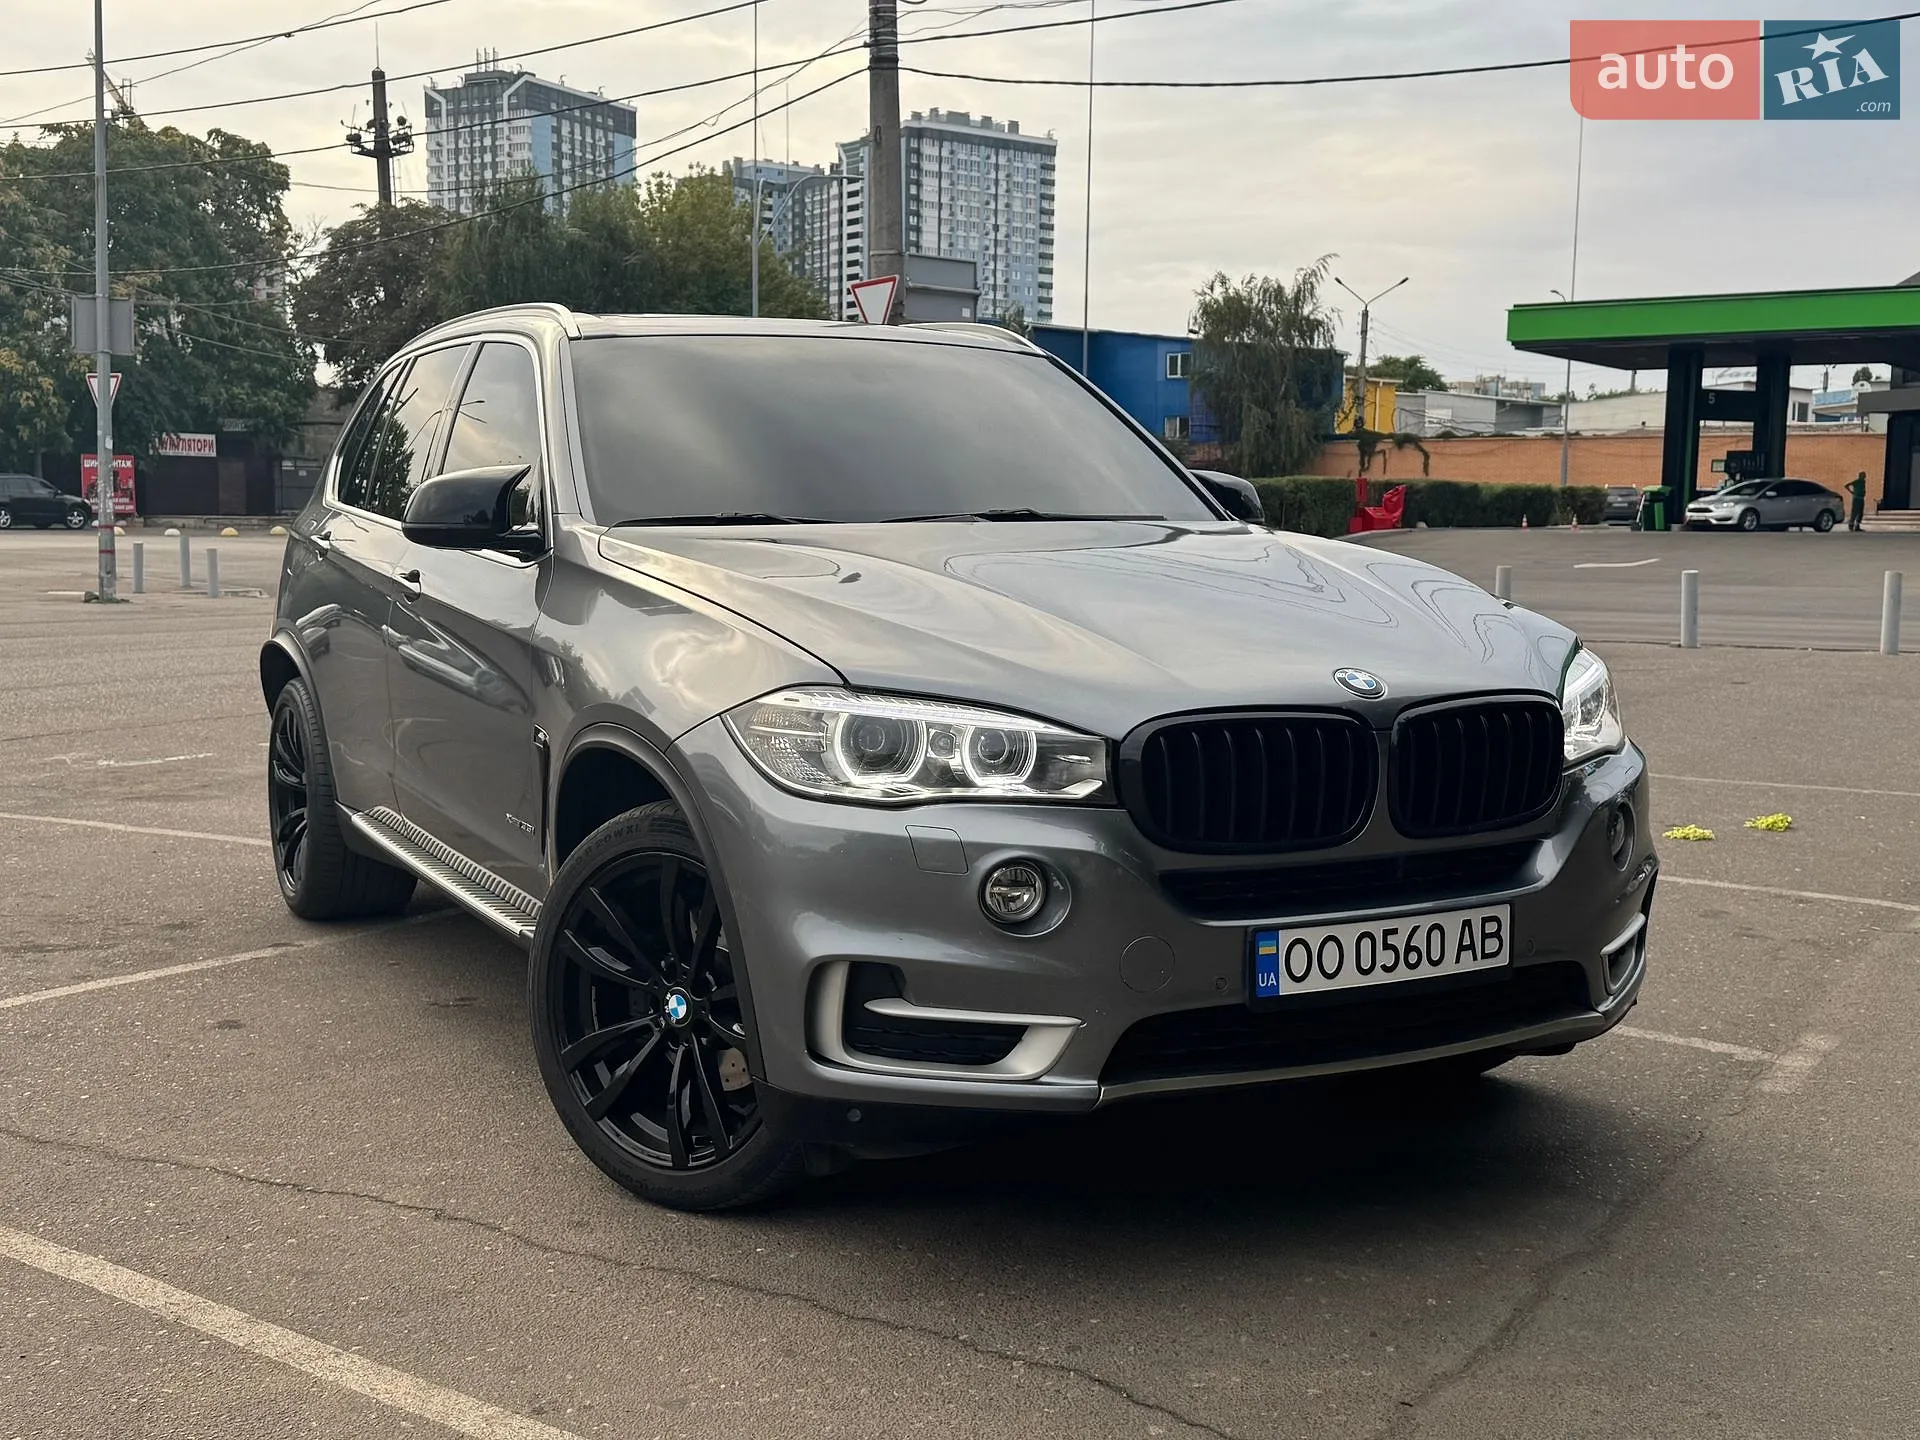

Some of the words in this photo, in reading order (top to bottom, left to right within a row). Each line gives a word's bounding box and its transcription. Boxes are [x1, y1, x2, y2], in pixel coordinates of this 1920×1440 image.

[1708, 393, 1716, 405] 5
[1284, 934, 1345, 984] OO
[1355, 922, 1446, 976] 0560
[1455, 915, 1504, 965] AB
[1258, 972, 1277, 987] UA
